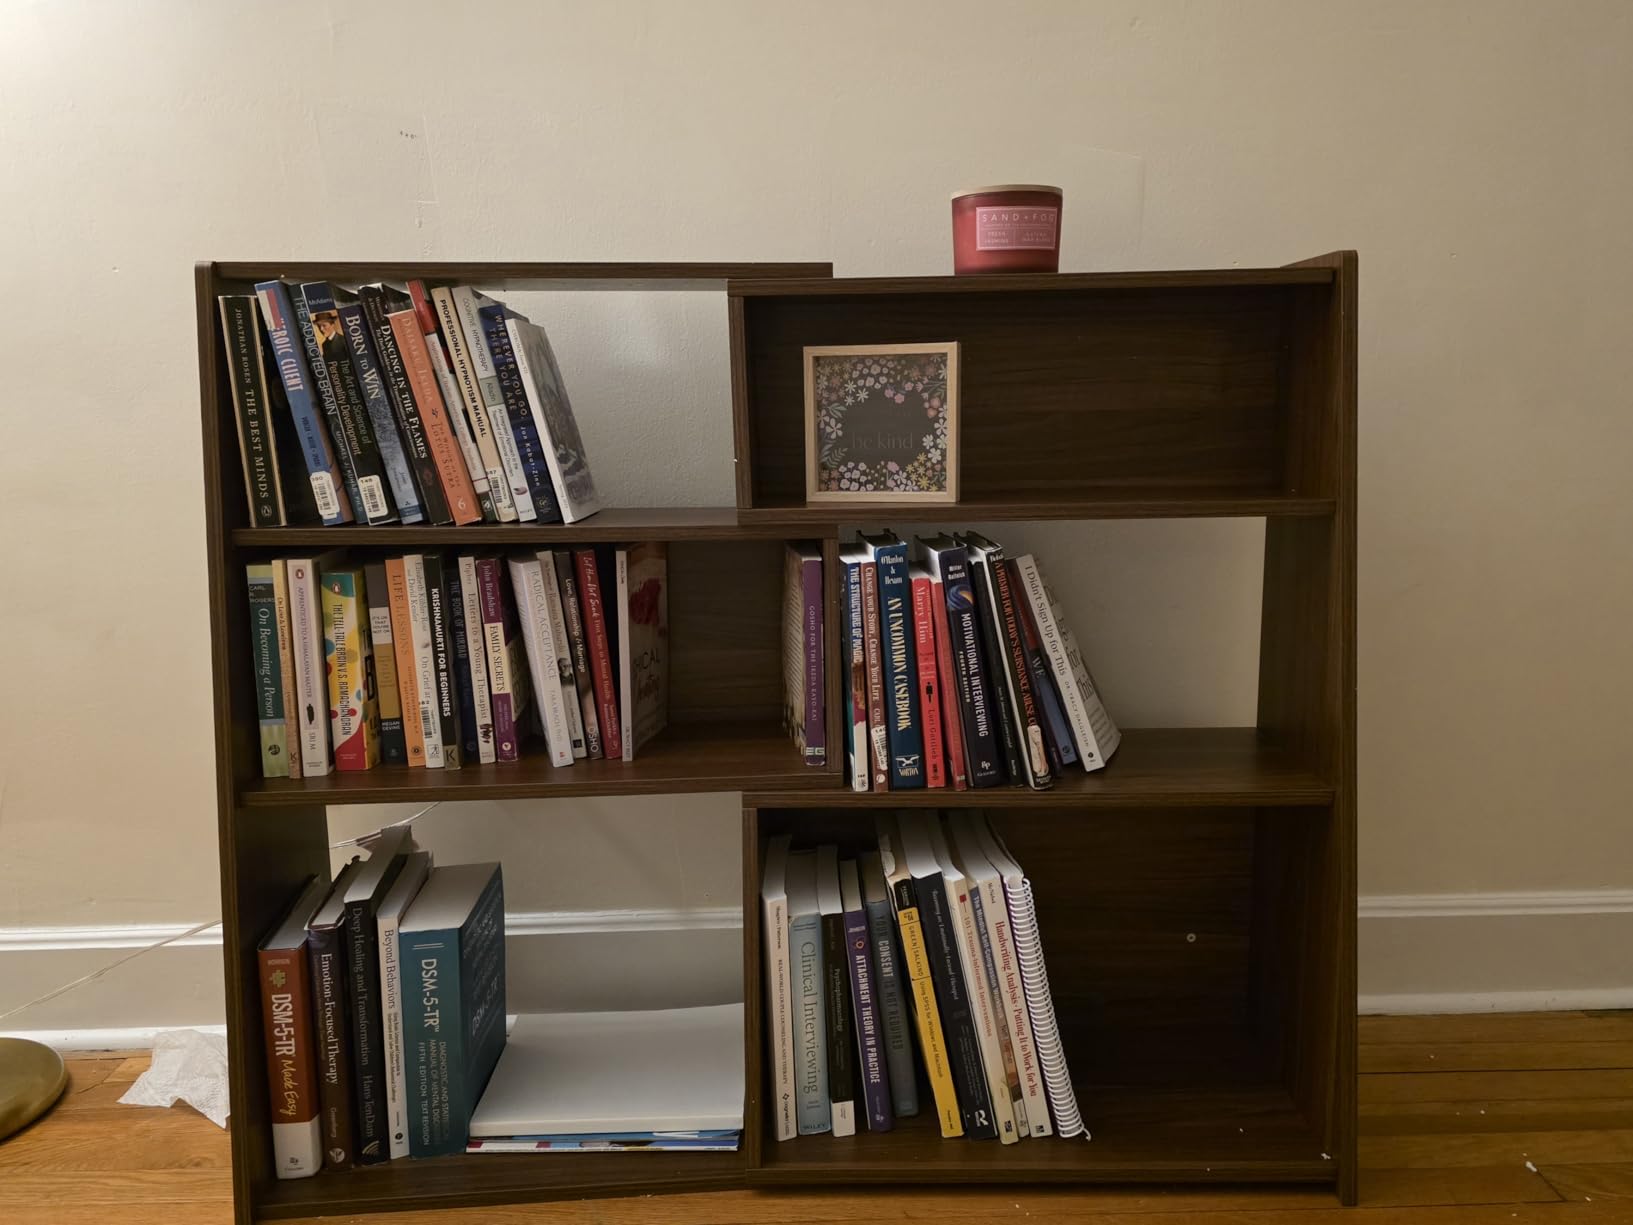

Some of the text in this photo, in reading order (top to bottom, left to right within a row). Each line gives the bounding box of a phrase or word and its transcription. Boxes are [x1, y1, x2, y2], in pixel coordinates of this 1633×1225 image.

[983, 214, 1020, 222] SAND
[235, 308, 251, 385] JONATHAN ROSEN
[294, 296, 337, 415] THE ADDICTED BRAIN
[346, 314, 381, 399] BORN TO WIN
[472, 329, 488, 373] HYPNOTHERAPY
[496, 314, 515, 370] WHEREVER
[511, 374, 522, 396] YOU
[281, 358, 304, 392] CLIENT
[440, 300, 487, 438] PROFESSIONAL HYPNOTISM MANUAL
[490, 328, 518, 411] THERE YOU ARE
[328, 360, 362, 456] Personality Development
[341, 360, 366, 434] The Art Science
[381, 325, 401, 374] DANCING
[396, 376, 407, 388] IN
[402, 392, 413, 414] THE
[409, 416, 428, 458] FLAMES
[245, 388, 269, 498] THE BEST MINDS
[852, 432, 913, 449] be kind
[482, 564, 496, 617] John Bradshaw
[850, 567, 860, 584] THE
[865, 567, 874, 594] CHANGE
[996, 569, 1011, 599] PRIMER
[258, 608, 270, 625] On
[333, 604, 344, 616] THE
[392, 576, 410, 656] LIFE LESSONS
[851, 584, 862, 628] STRUCTURE
[915, 586, 928, 644] Marry Him
[1002, 600, 1014, 615] FOR
[334, 618, 346, 646] TELL-TALE
[490, 626, 502, 654] FAMILY
[531, 570, 558, 681] RADICAL ACCEPTANCE
[569, 598, 586, 672] Relationship Marriage
[853, 628, 864, 639] OF
[1004, 616, 1019, 647] TODAY'S
[1027, 572, 1067, 677] Didn't Sign Up for This
[259, 628, 273, 676] Becoming
[336, 647, 348, 668] BRAIN
[421, 656, 430, 668] On
[432, 588, 451, 718] KRISHNAMURTI FOR BEGINNERS
[468, 592, 489, 720] Letters Young Therapist
[870, 638, 878, 664] CHANGE
[888, 597, 912, 732] AN UNCOMMON CASEBOOK
[1032, 656, 1045, 678] WE
[423, 670, 433, 690] Grief
[494, 656, 504, 692] SECRETS
[872, 666, 880, 684] YOUR
[961, 613, 989, 738] MOTIVATIONAL INTERVIEWING
[1012, 648, 1030, 692] SUBSTANCE
[264, 687, 276, 717] Person
[872, 684, 881, 702] LIFE
[963, 676, 971, 703] EDITION
[1021, 692, 1034, 716] ABUSE
[1069, 692, 1079, 713] TRACY
[338, 682, 352, 736] RAMACHANDRAN
[587, 726, 600, 752] OSHO
[928, 709, 938, 760] Lori Gottlieb
[908, 926, 916, 948] GREEN
[976, 908, 986, 934] Mindful
[383, 929, 396, 964] Beyond
[878, 940, 894, 978] CONSENT
[980, 934, 998, 990] Self-Compassion
[994, 921, 1012, 971] Handwriting
[351, 908, 374, 1066] Deep Healing and Transformation
[386, 966, 398, 1010] Behaviors
[1005, 972, 1021, 1004] Analysis
[321, 953, 341, 1085] Emotion-Focused Therapy
[801, 942, 822, 1094] Clinical Interviewing
[856, 956, 880, 1084] ATTACHMENT THEORY IN PRACTICE
[922, 996, 932, 1012] SPSS
[979, 991, 992, 1037] Interventions
[1013, 1008, 1026, 1036] Putting
[281, 1060, 299, 1090] Made
[439, 1041, 449, 1084] DIAGNOSTIC
[1022, 1053, 1034, 1072] Work
[1028, 1072, 1036, 1083] for
[362, 1074, 374, 1100] Hans
[420, 1066, 428, 1097] EDITION
[432, 1082, 440, 1108] MENTAL
[442, 1086, 450, 1102] AND
[1030, 1083, 1039, 1097] You
[280, 1090, 300, 1116] Easy
[421, 1100, 429, 1115] TEXT
